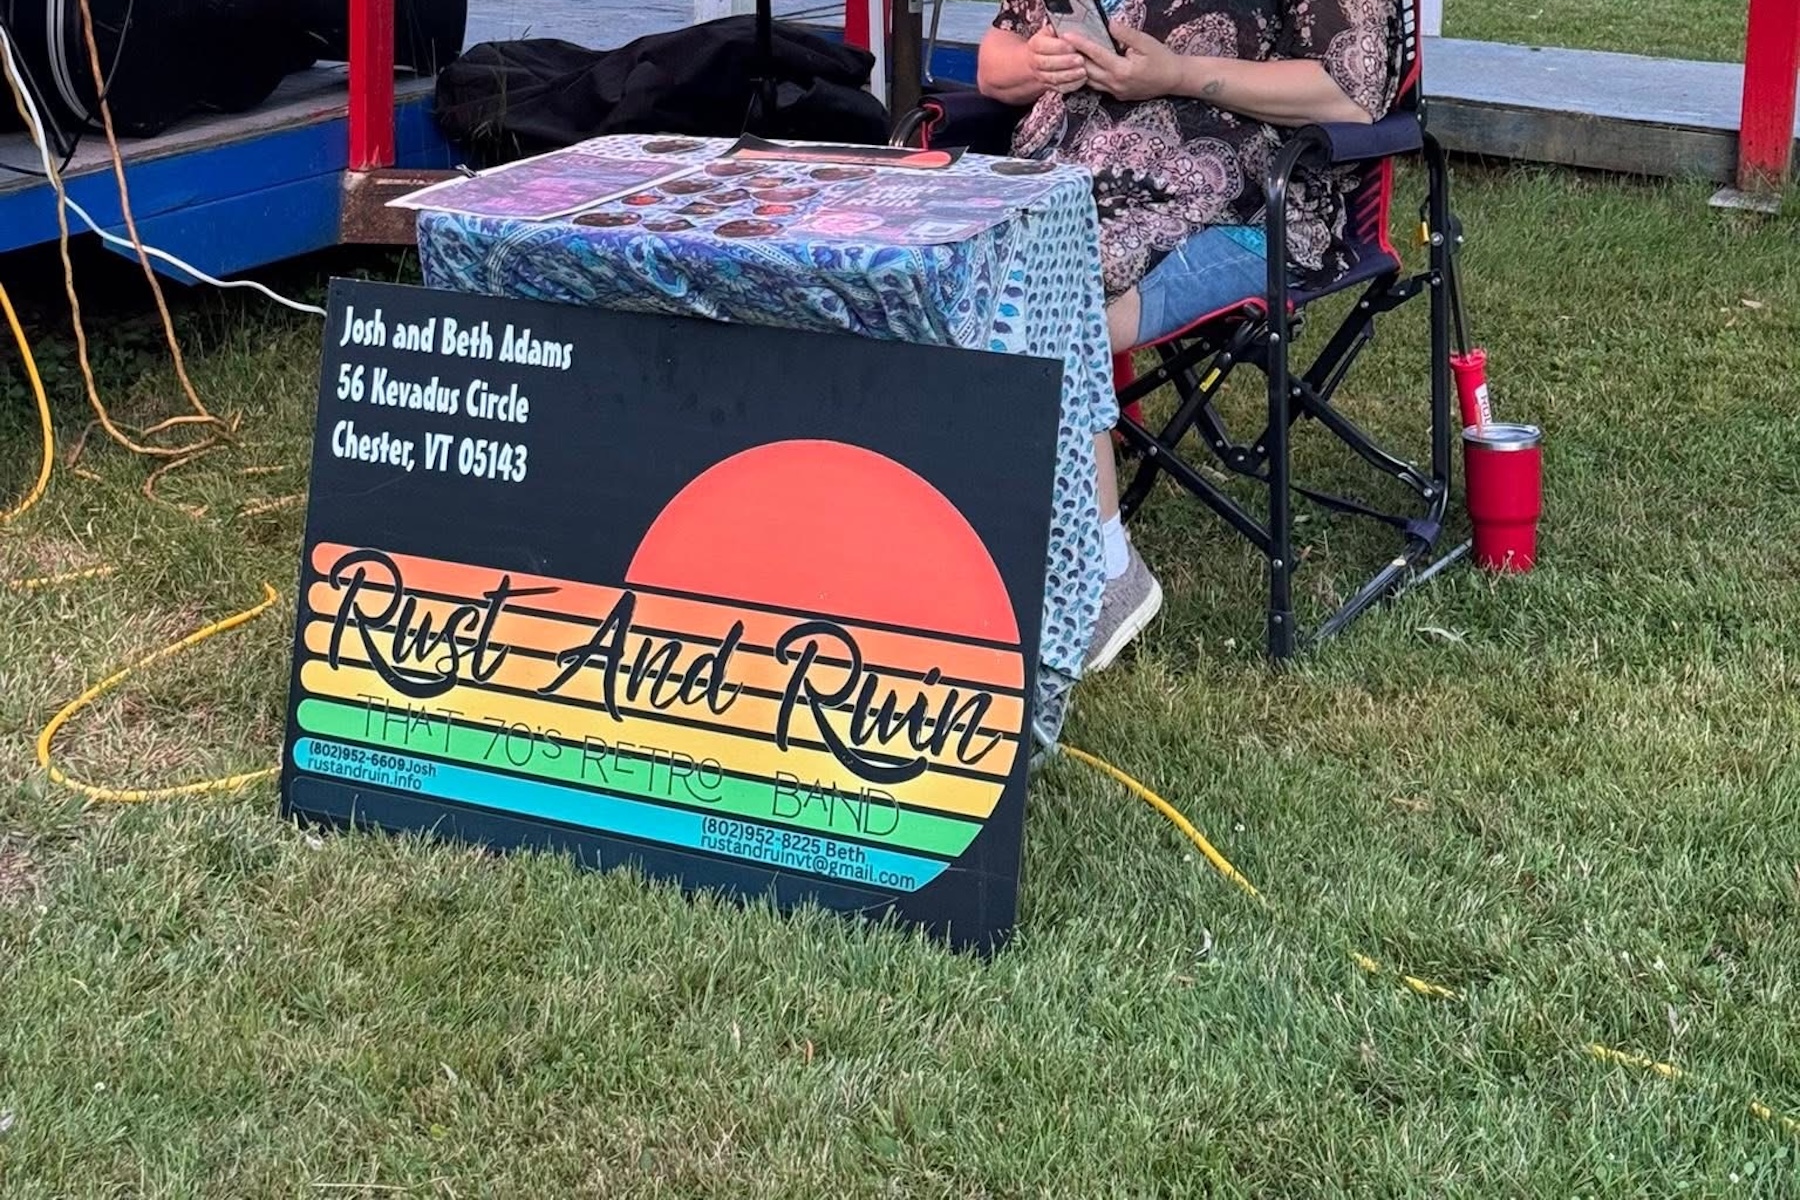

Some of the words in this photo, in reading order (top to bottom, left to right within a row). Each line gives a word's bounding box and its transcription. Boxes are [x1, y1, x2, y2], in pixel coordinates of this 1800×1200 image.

[340, 305, 386, 347] Josh
[392, 318, 436, 352] and
[441, 317, 493, 360] Beth
[499, 324, 573, 370] Adams
[337, 363, 365, 402] 56
[370, 367, 460, 415] Kevadus
[465, 379, 530, 423] Circle
[332, 420, 415, 472] Chester,
[424, 432, 454, 472] VT
[458, 437, 528, 483] 05143
[329, 549, 562, 698] Rust
[538, 590, 743, 722] And
[776, 620, 1003, 784] Ruin
[307, 757, 422, 790] rustandruin.info
[357, 693, 464, 752] THAT
[483, 717, 562, 766] 70'S
[581, 735, 723, 802] RETRO
[772, 771, 900, 836] BAND
[701, 834, 915, 890] rustandruinvt@gmail.com
[702, 816, 821, 855] (802)952-8225
[826, 841, 866, 864] Beth
